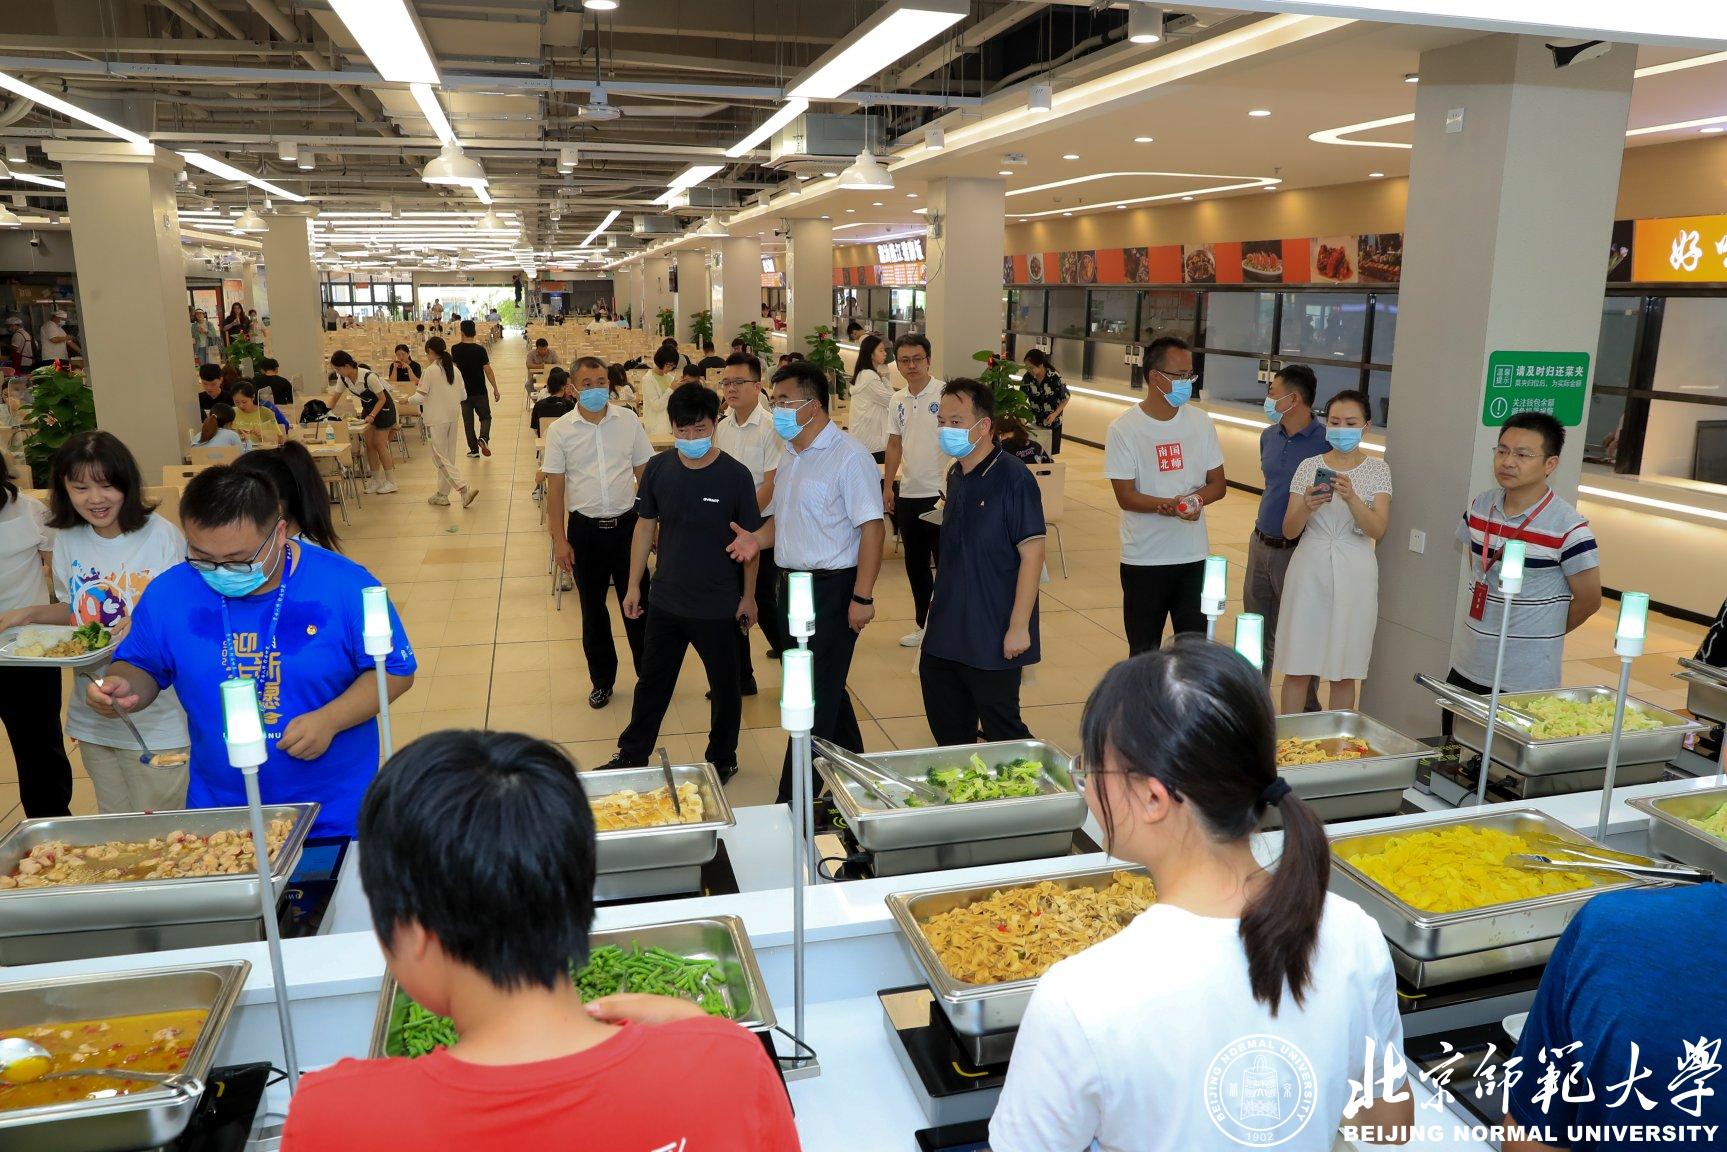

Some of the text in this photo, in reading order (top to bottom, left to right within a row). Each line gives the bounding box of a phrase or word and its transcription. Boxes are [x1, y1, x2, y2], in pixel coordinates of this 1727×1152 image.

[1516, 366, 1584, 377] 请及时归还菜夹
